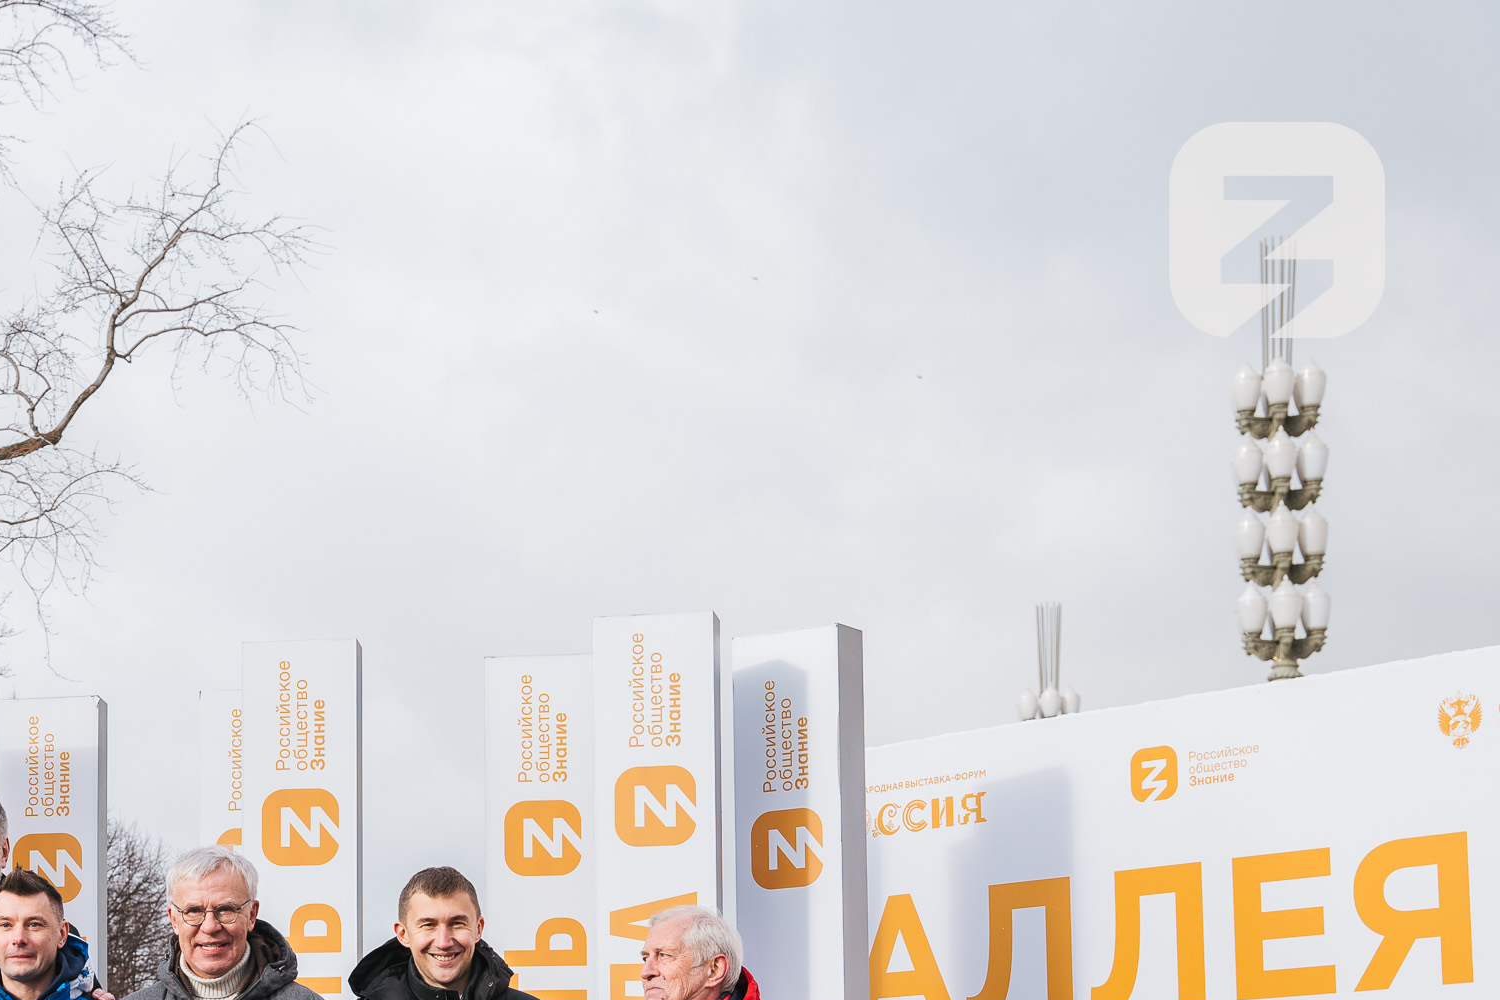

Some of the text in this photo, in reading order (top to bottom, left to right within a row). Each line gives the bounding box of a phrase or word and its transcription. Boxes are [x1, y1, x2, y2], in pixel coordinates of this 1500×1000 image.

[275, 660, 291, 771] Российское
[292, 679, 311, 772] общество
[517, 674, 534, 783] Российское
[628, 633, 645, 748] Российское
[647, 652, 666, 748] общество
[665, 672, 682, 747] Знание
[24, 715, 40, 818] Российское
[40, 733, 57, 818] общество
[227, 707, 243, 812] Российское
[309, 699, 326, 771] Знание
[535, 692, 553, 784] общество
[552, 712, 568, 783] Знание
[761, 680, 778, 794] Российское
[778, 697, 795, 792] общество
[794, 716, 810, 791] Знание
[1188, 744, 1260, 763] Российское
[1188, 758, 1248, 775] общество
[55, 751, 71, 817] Знание
[866, 791, 987, 837] ССИЯ
[905, 769, 987, 789] ВЫСТАВКА-ФОРУМ
[1189, 773, 1235, 787] Знание
